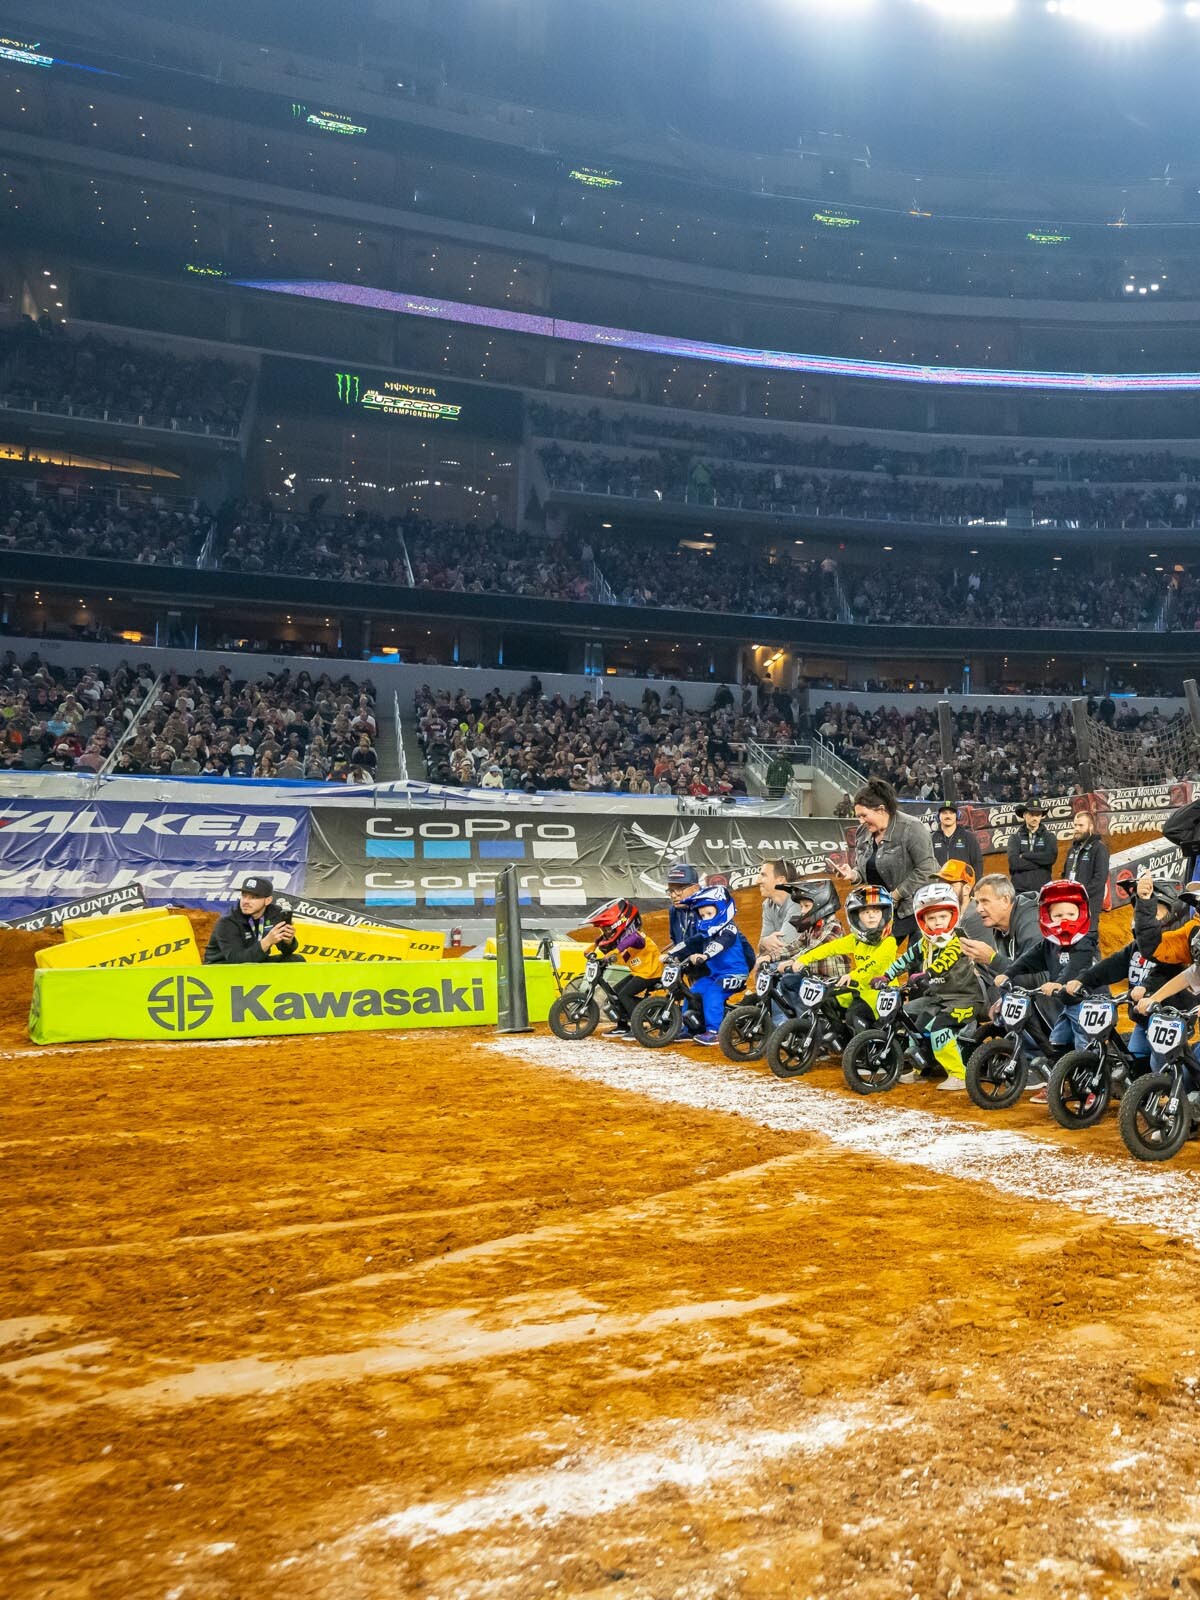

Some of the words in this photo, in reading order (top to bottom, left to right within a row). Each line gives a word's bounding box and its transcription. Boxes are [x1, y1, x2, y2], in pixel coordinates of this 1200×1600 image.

[384, 381, 437, 397] MONSTER
[362, 393, 462, 416] SUPERCROSS
[383, 406, 440, 420] CHAMPIONSHIP
[1116, 789, 1136, 799] ROCKY
[1136, 787, 1169, 797] MOUNTAIN
[1000, 804, 1016, 814] ROC
[1040, 797, 1070, 807] UNTAIN
[1118, 814, 1138, 823] ROCKY
[1138, 812, 1171, 822] MOUNTAIN
[366, 817, 576, 838] GoPro
[215, 839, 288, 852] TIRES
[705, 839, 753, 849] U.S.
[757, 839, 800, 850] AIR
[805, 840, 849, 851] FOR
[743, 865, 763, 876] ROC
[791, 854, 826, 866] UNTAIN
[1150, 853, 1175, 869] ROCKY
[51, 886, 140, 925] MOUNTAIN
[295, 901, 345, 923] ROCKY
[15, 917, 46, 933] CKY
[88, 938, 191, 968] UNLOP
[410, 942, 440, 952] LOP
[231, 977, 485, 1023] Kawasaki
[802, 986, 820, 1001] 107
[879, 997, 894, 1011] 106
[1005, 1003, 1023, 1019] 105
[1083, 1010, 1107, 1027] 104
[934, 1030, 951, 1047] FOX
[1152, 1025, 1177, 1046] 103
